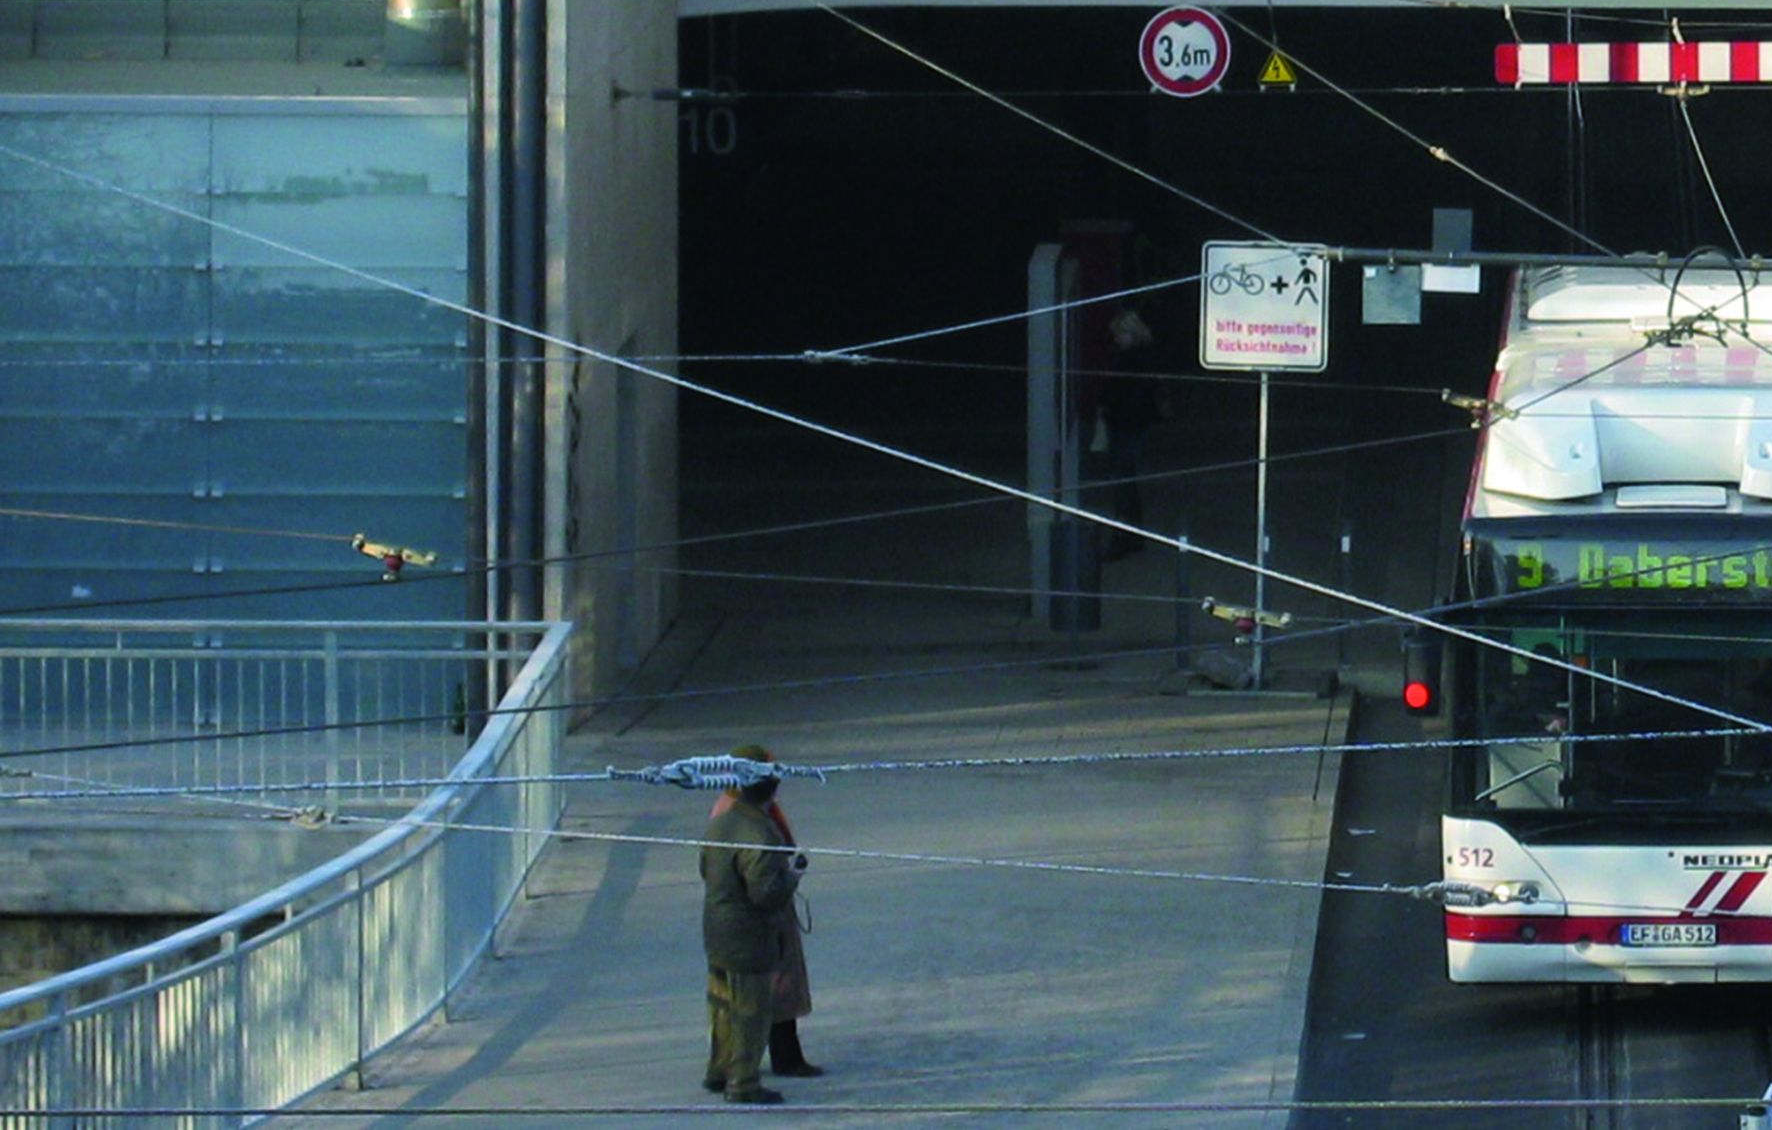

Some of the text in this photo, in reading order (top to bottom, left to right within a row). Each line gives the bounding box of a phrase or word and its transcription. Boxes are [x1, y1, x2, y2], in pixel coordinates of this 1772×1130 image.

[1216, 321, 1317, 338] bitte gegenseitige
[1458, 848, 1495, 868] 512
[1631, 926, 1714, 943] EF GA 512
